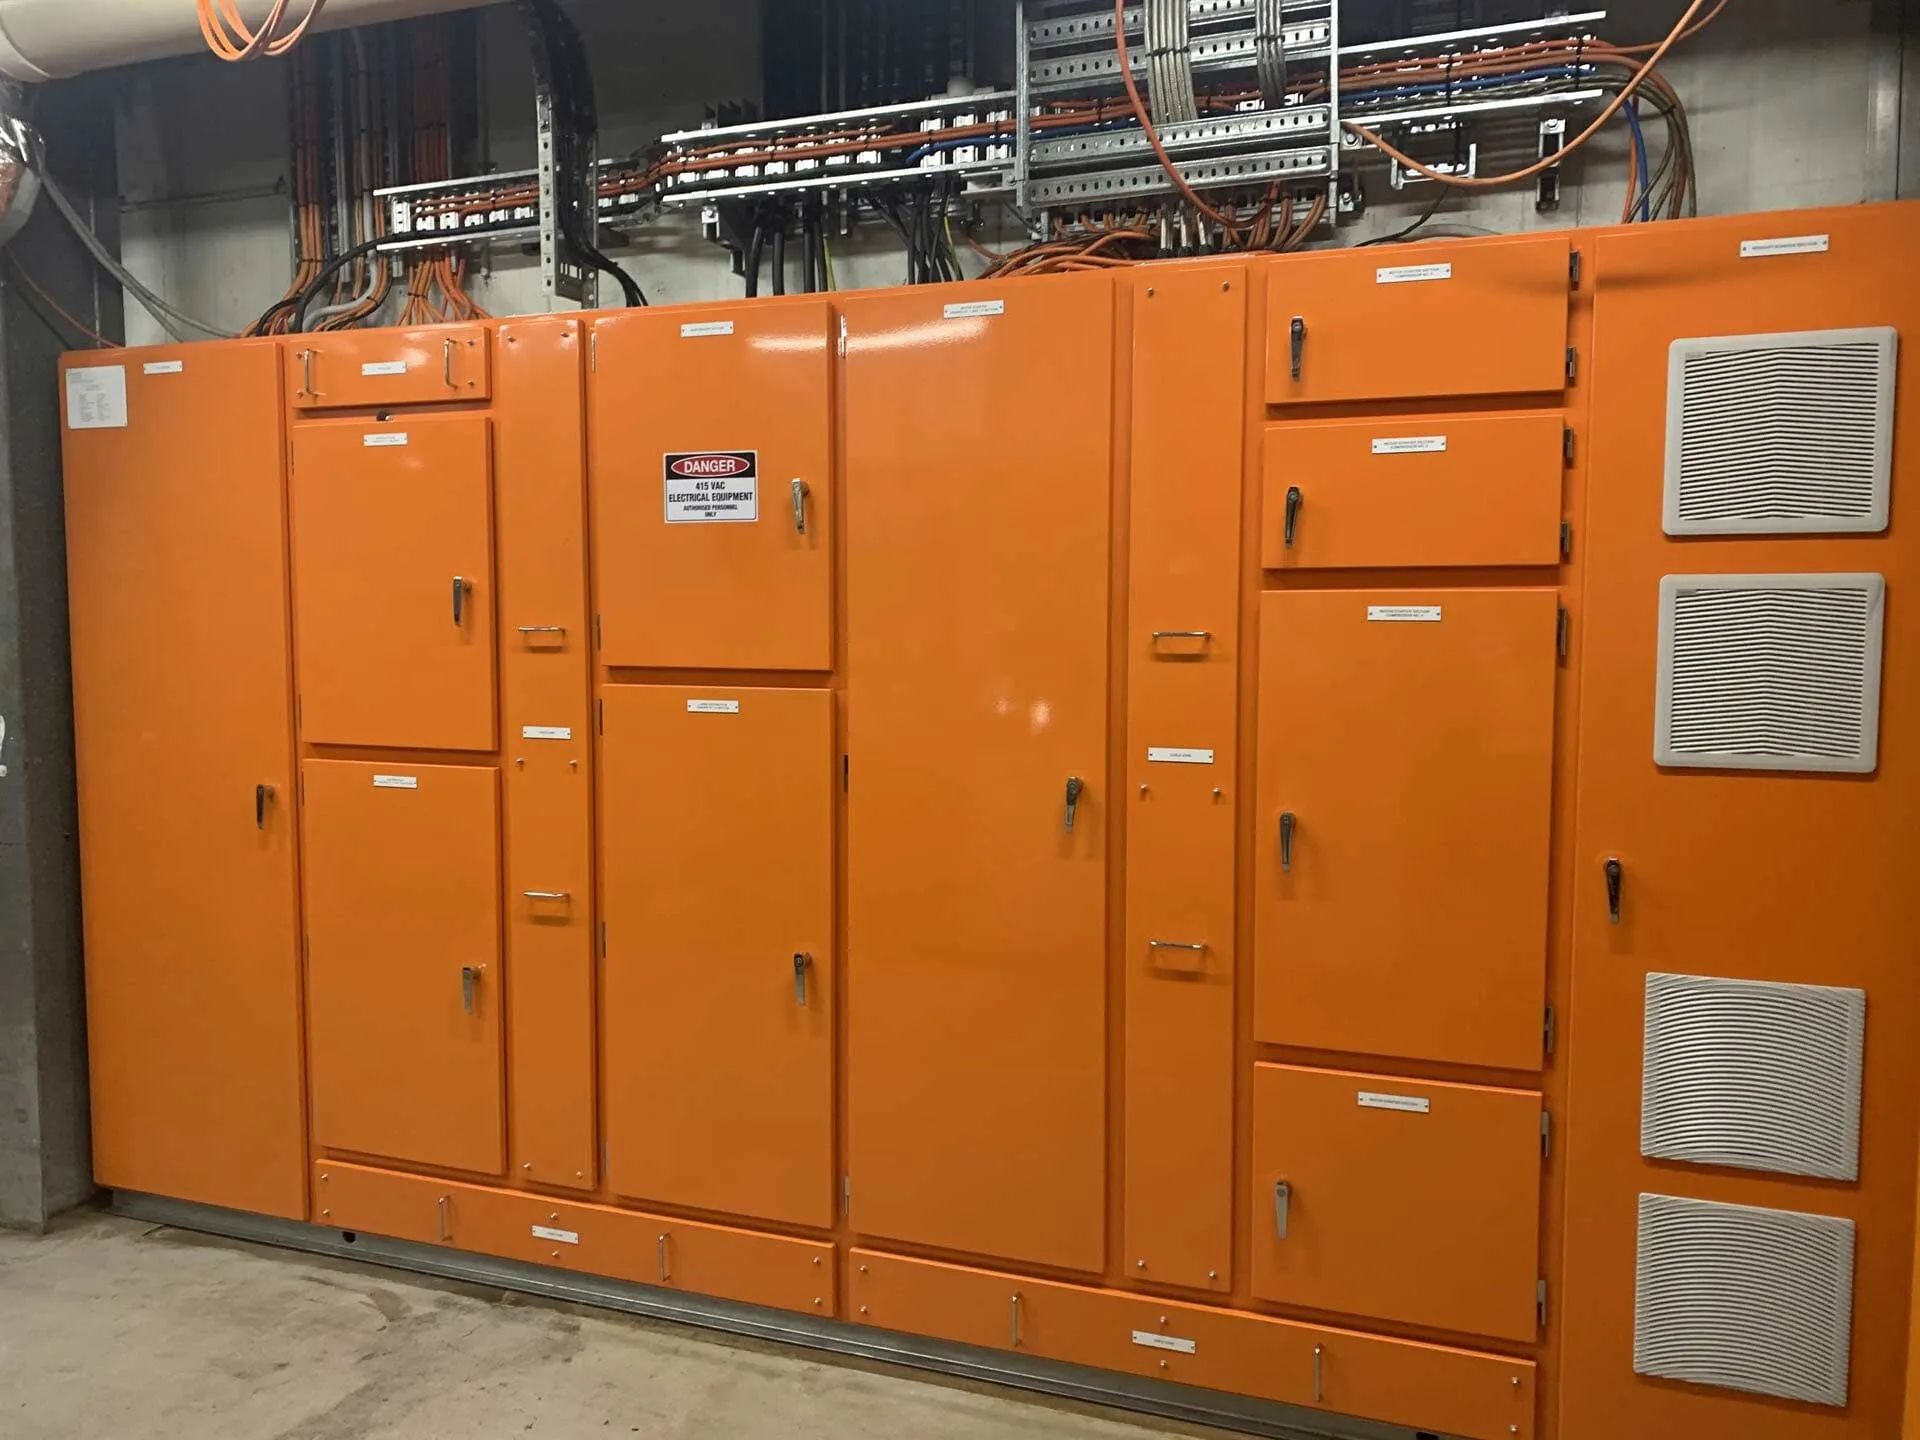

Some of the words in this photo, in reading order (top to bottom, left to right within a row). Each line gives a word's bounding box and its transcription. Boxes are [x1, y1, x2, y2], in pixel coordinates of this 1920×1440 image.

[684, 459, 736, 473] DANGER
[695, 482, 709, 491] 415
[710, 481, 725, 490] VAC
[669, 493, 710, 503] ELECTRICAL
[711, 491, 753, 502] EQUIPMENT
